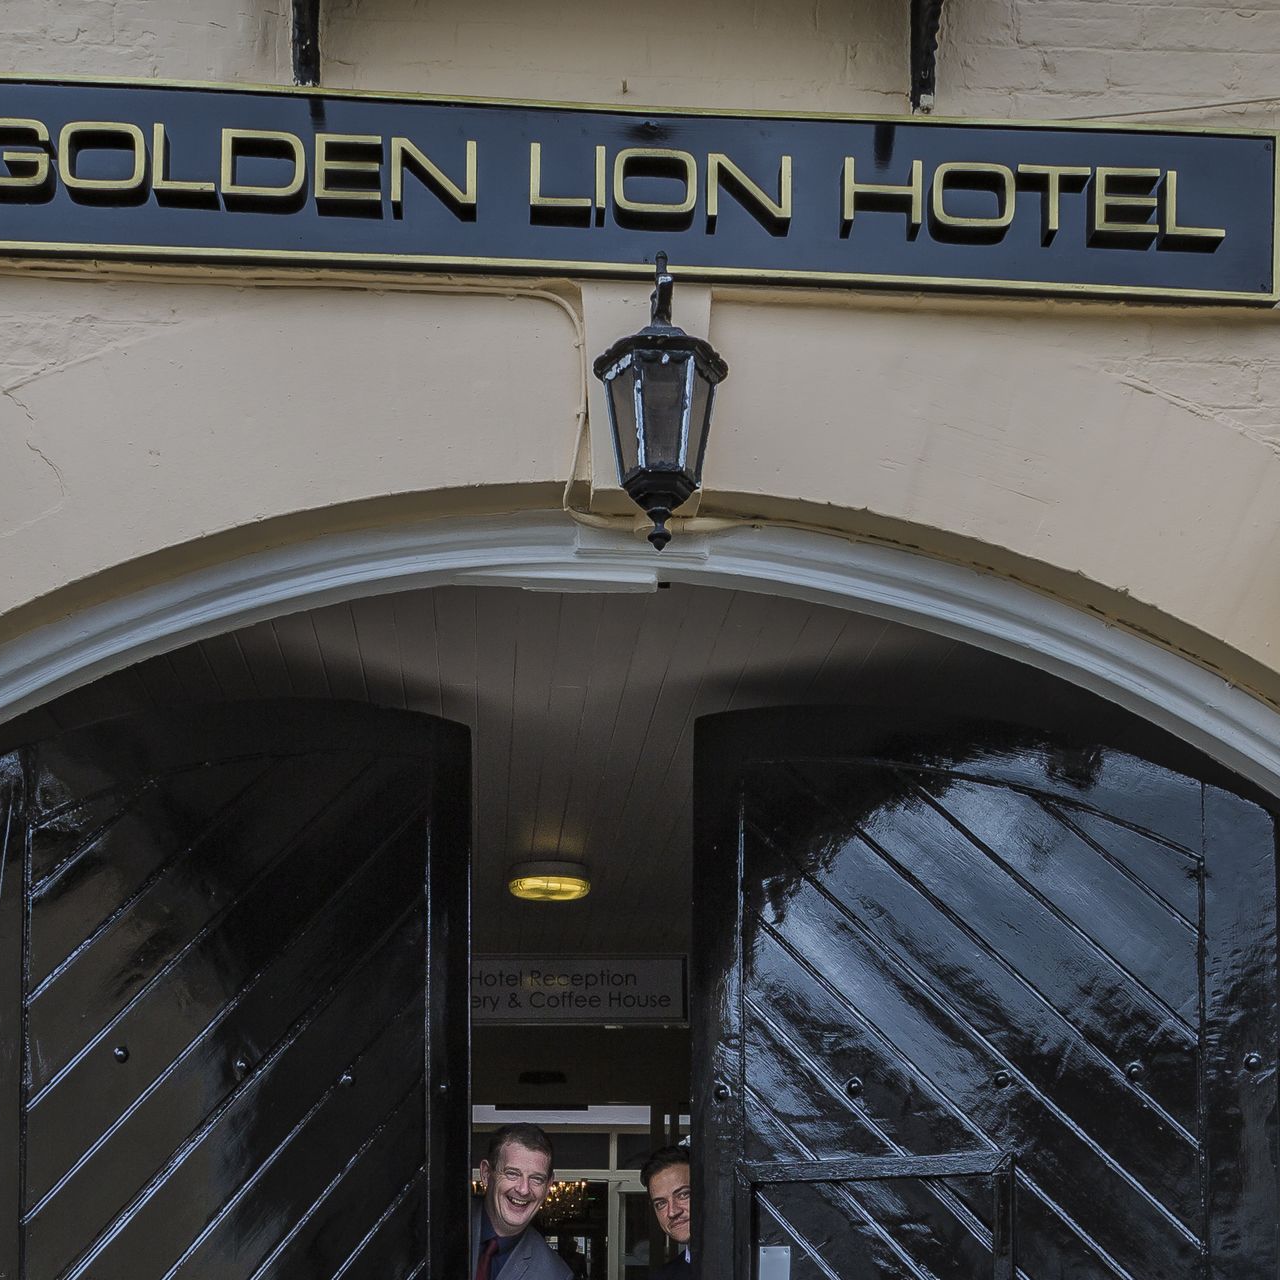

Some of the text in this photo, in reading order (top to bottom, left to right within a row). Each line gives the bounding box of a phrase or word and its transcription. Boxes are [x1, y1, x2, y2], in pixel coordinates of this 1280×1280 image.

[530, 142, 792, 218] LION
[843, 156, 1226, 238] HOTEL
[471, 969, 637, 990] Hotel Reception
[508, 992, 522, 1008] &
[530, 991, 601, 1009] Coffee
[608, 991, 671, 1008] House
